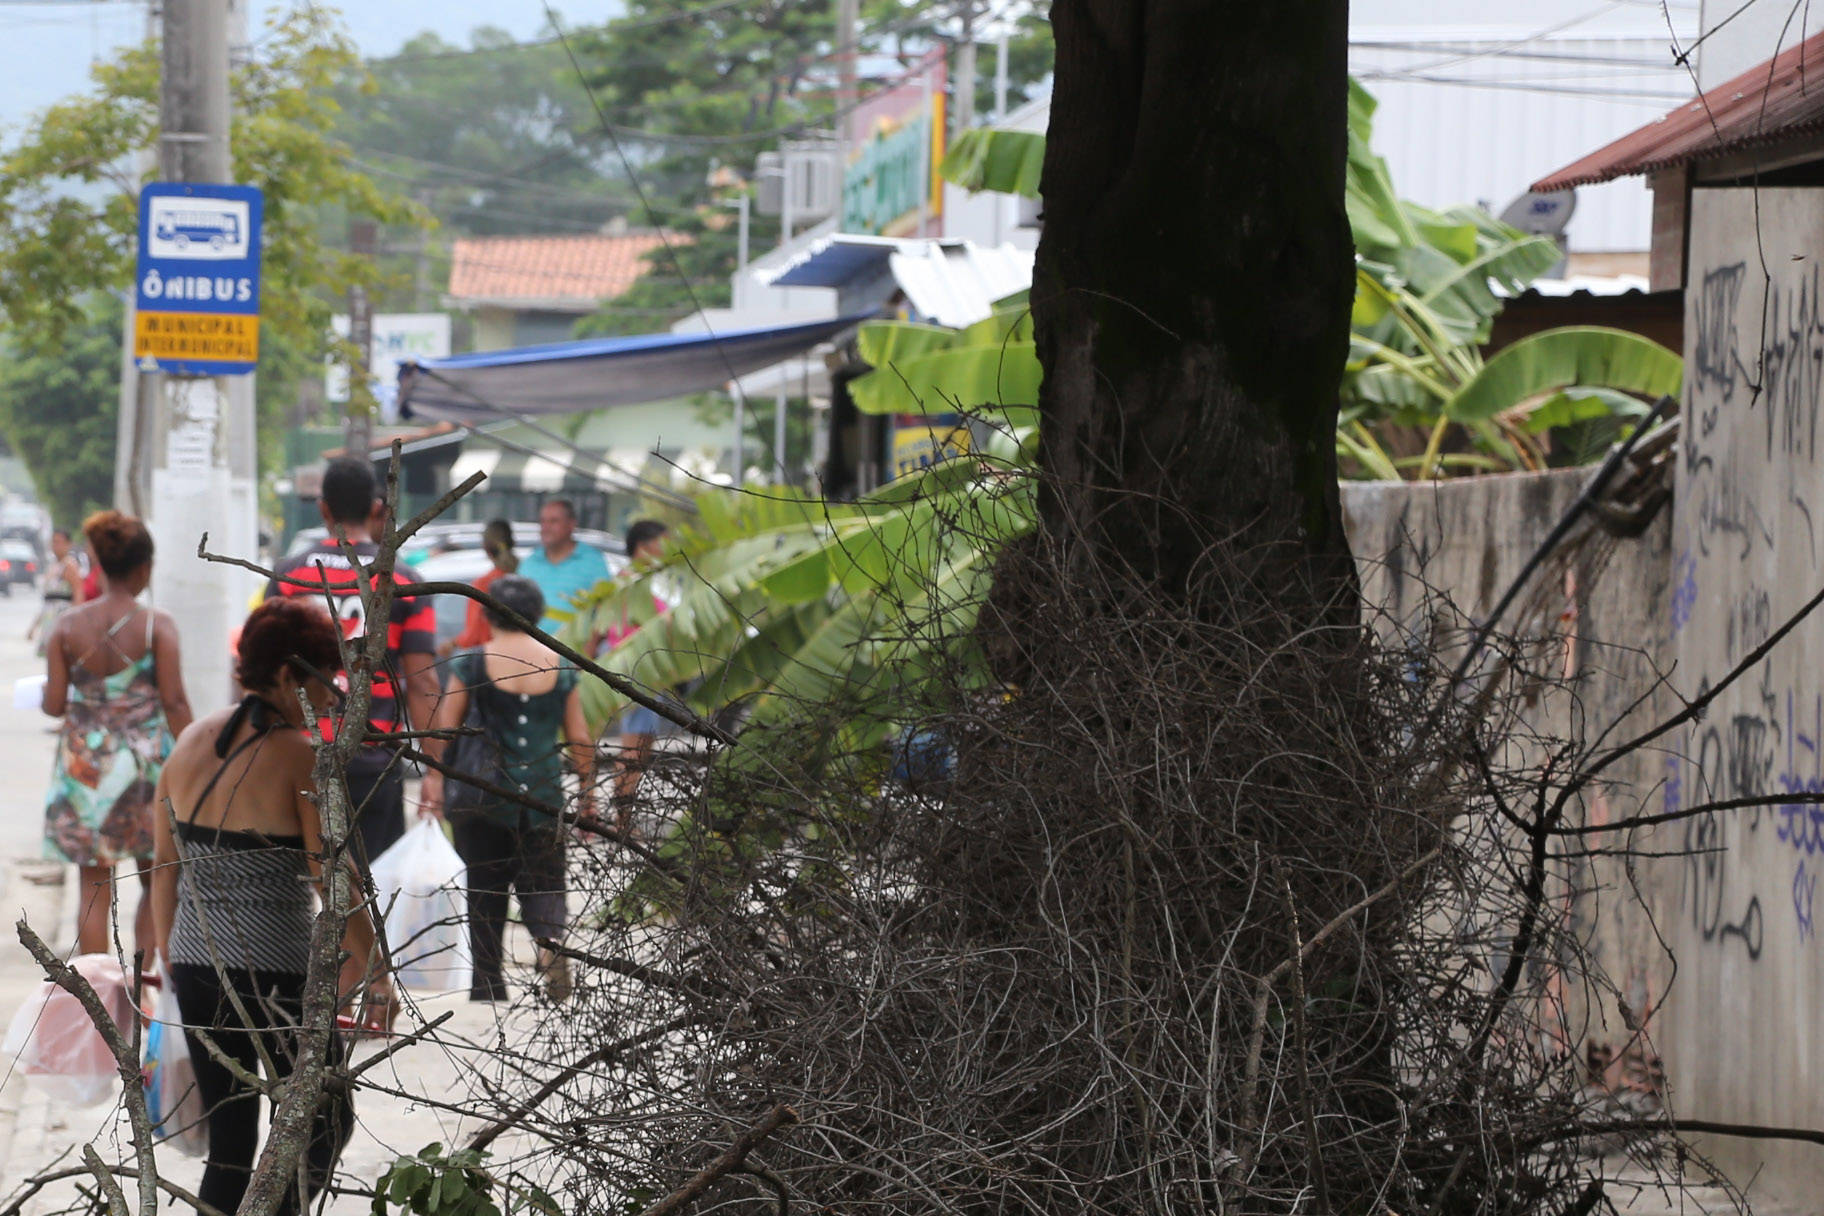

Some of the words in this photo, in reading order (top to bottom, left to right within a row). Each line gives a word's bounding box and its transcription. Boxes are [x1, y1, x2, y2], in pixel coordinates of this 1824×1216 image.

[142, 268, 252, 301] ÔNIBUS
[145, 317, 245, 336] MUNICIPAL
[138, 336, 253, 356] INTERMUNICIPAL
